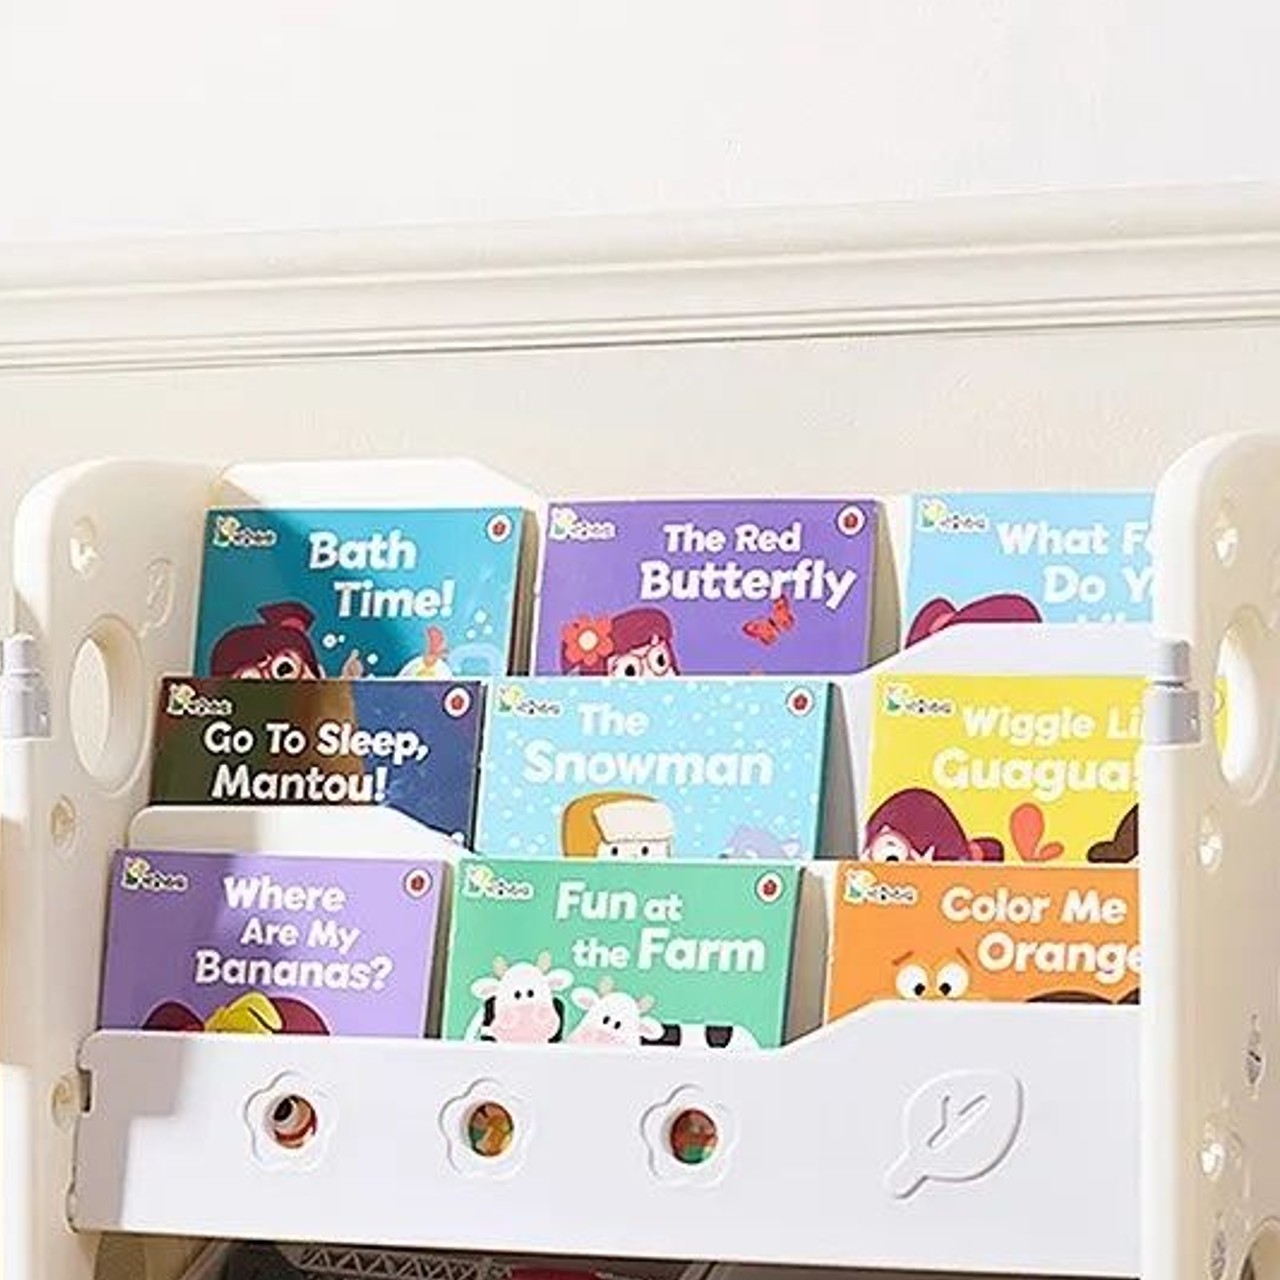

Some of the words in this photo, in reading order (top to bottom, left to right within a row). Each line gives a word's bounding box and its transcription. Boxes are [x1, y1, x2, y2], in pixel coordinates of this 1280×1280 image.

[308, 530, 418, 571] Bath
[662, 522, 727, 553] The
[735, 521, 802, 553] Red
[996, 520, 1110, 556] What
[334, 580, 456, 619] Time!
[639, 558, 858, 611] Butterfly
[1043, 564, 1107, 604] Do
[1121, 567, 1154, 604] Y
[576, 702, 649, 736] The
[962, 705, 1096, 748] Wiggle
[203, 721, 255, 756] Go
[265, 722, 307, 757] To
[315, 722, 430, 765] Sleep,
[522, 738, 774, 786] Snowman
[211, 764, 389, 804] Mantou!
[223, 876, 346, 913] Where
[555, 880, 638, 921] Fun
[642, 893, 684, 922] at
[940, 884, 1051, 924] Color
[1060, 888, 1128, 925] Me
[240, 918, 298, 948] Are
[307, 918, 361, 954] My
[571, 936, 631, 969] the
[637, 927, 766, 972] Farm
[194, 950, 394, 992] Bananas?
